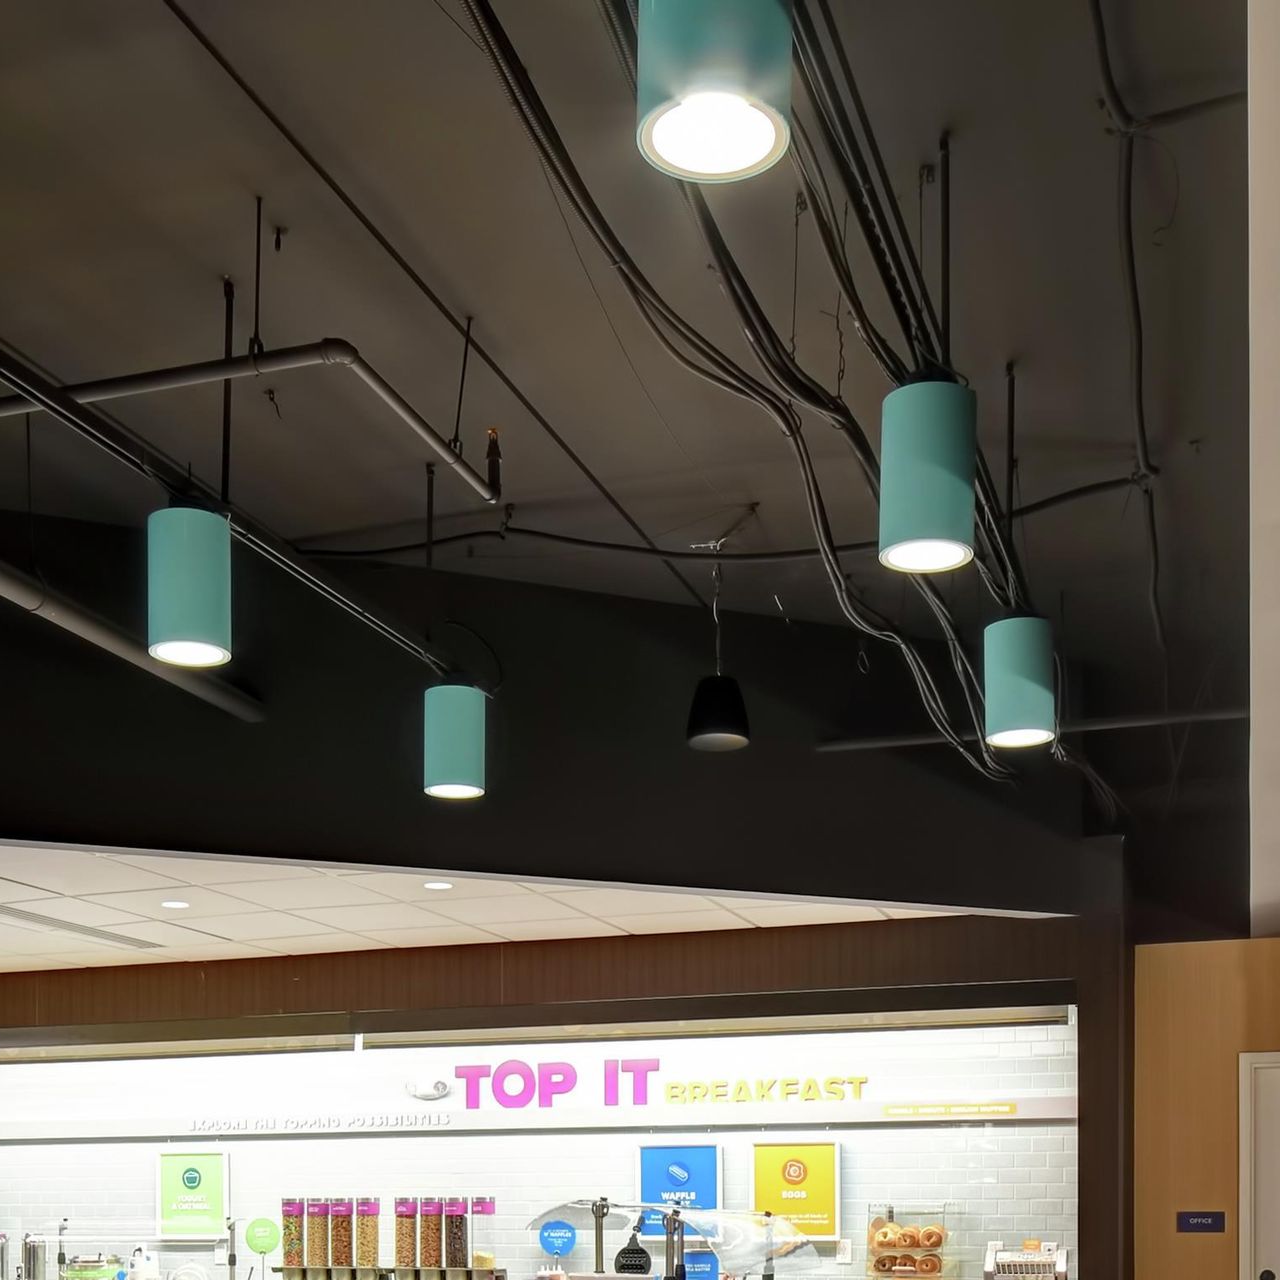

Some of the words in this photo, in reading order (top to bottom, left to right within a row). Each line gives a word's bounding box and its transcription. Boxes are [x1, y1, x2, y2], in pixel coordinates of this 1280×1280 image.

[455, 1059, 577, 1109] TOP
[604, 1058, 660, 1106] IT
[663, 1075, 869, 1103] BREAKFAST
[189, 1119, 247, 1132] EXPLORE
[254, 1118, 275, 1130] THE
[283, 1116, 340, 1130] TOPPING
[347, 1113, 450, 1128] POSSIBILITIES
[661, 1191, 696, 1200] WAFFLE
[781, 1191, 807, 1199] EGGS
